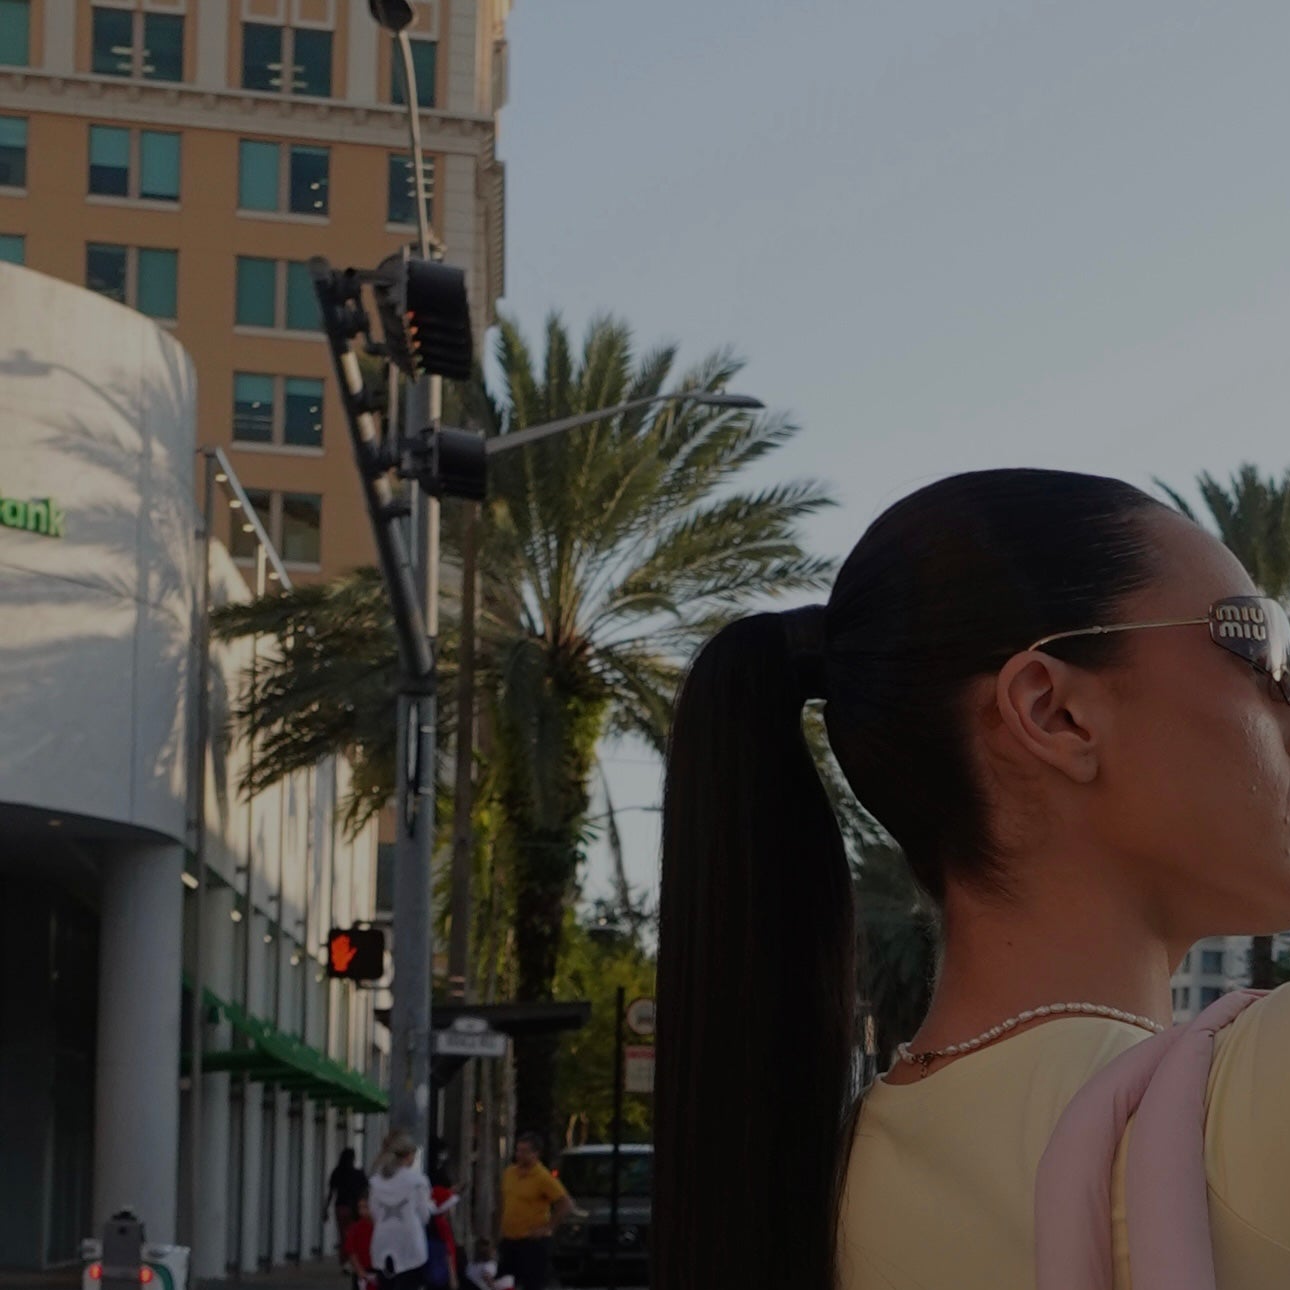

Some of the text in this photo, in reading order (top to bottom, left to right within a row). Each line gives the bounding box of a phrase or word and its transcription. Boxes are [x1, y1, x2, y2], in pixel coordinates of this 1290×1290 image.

[0, 497, 66, 538] ank
[1216, 605, 1264, 623] miu
[1219, 622, 1267, 641] miu
